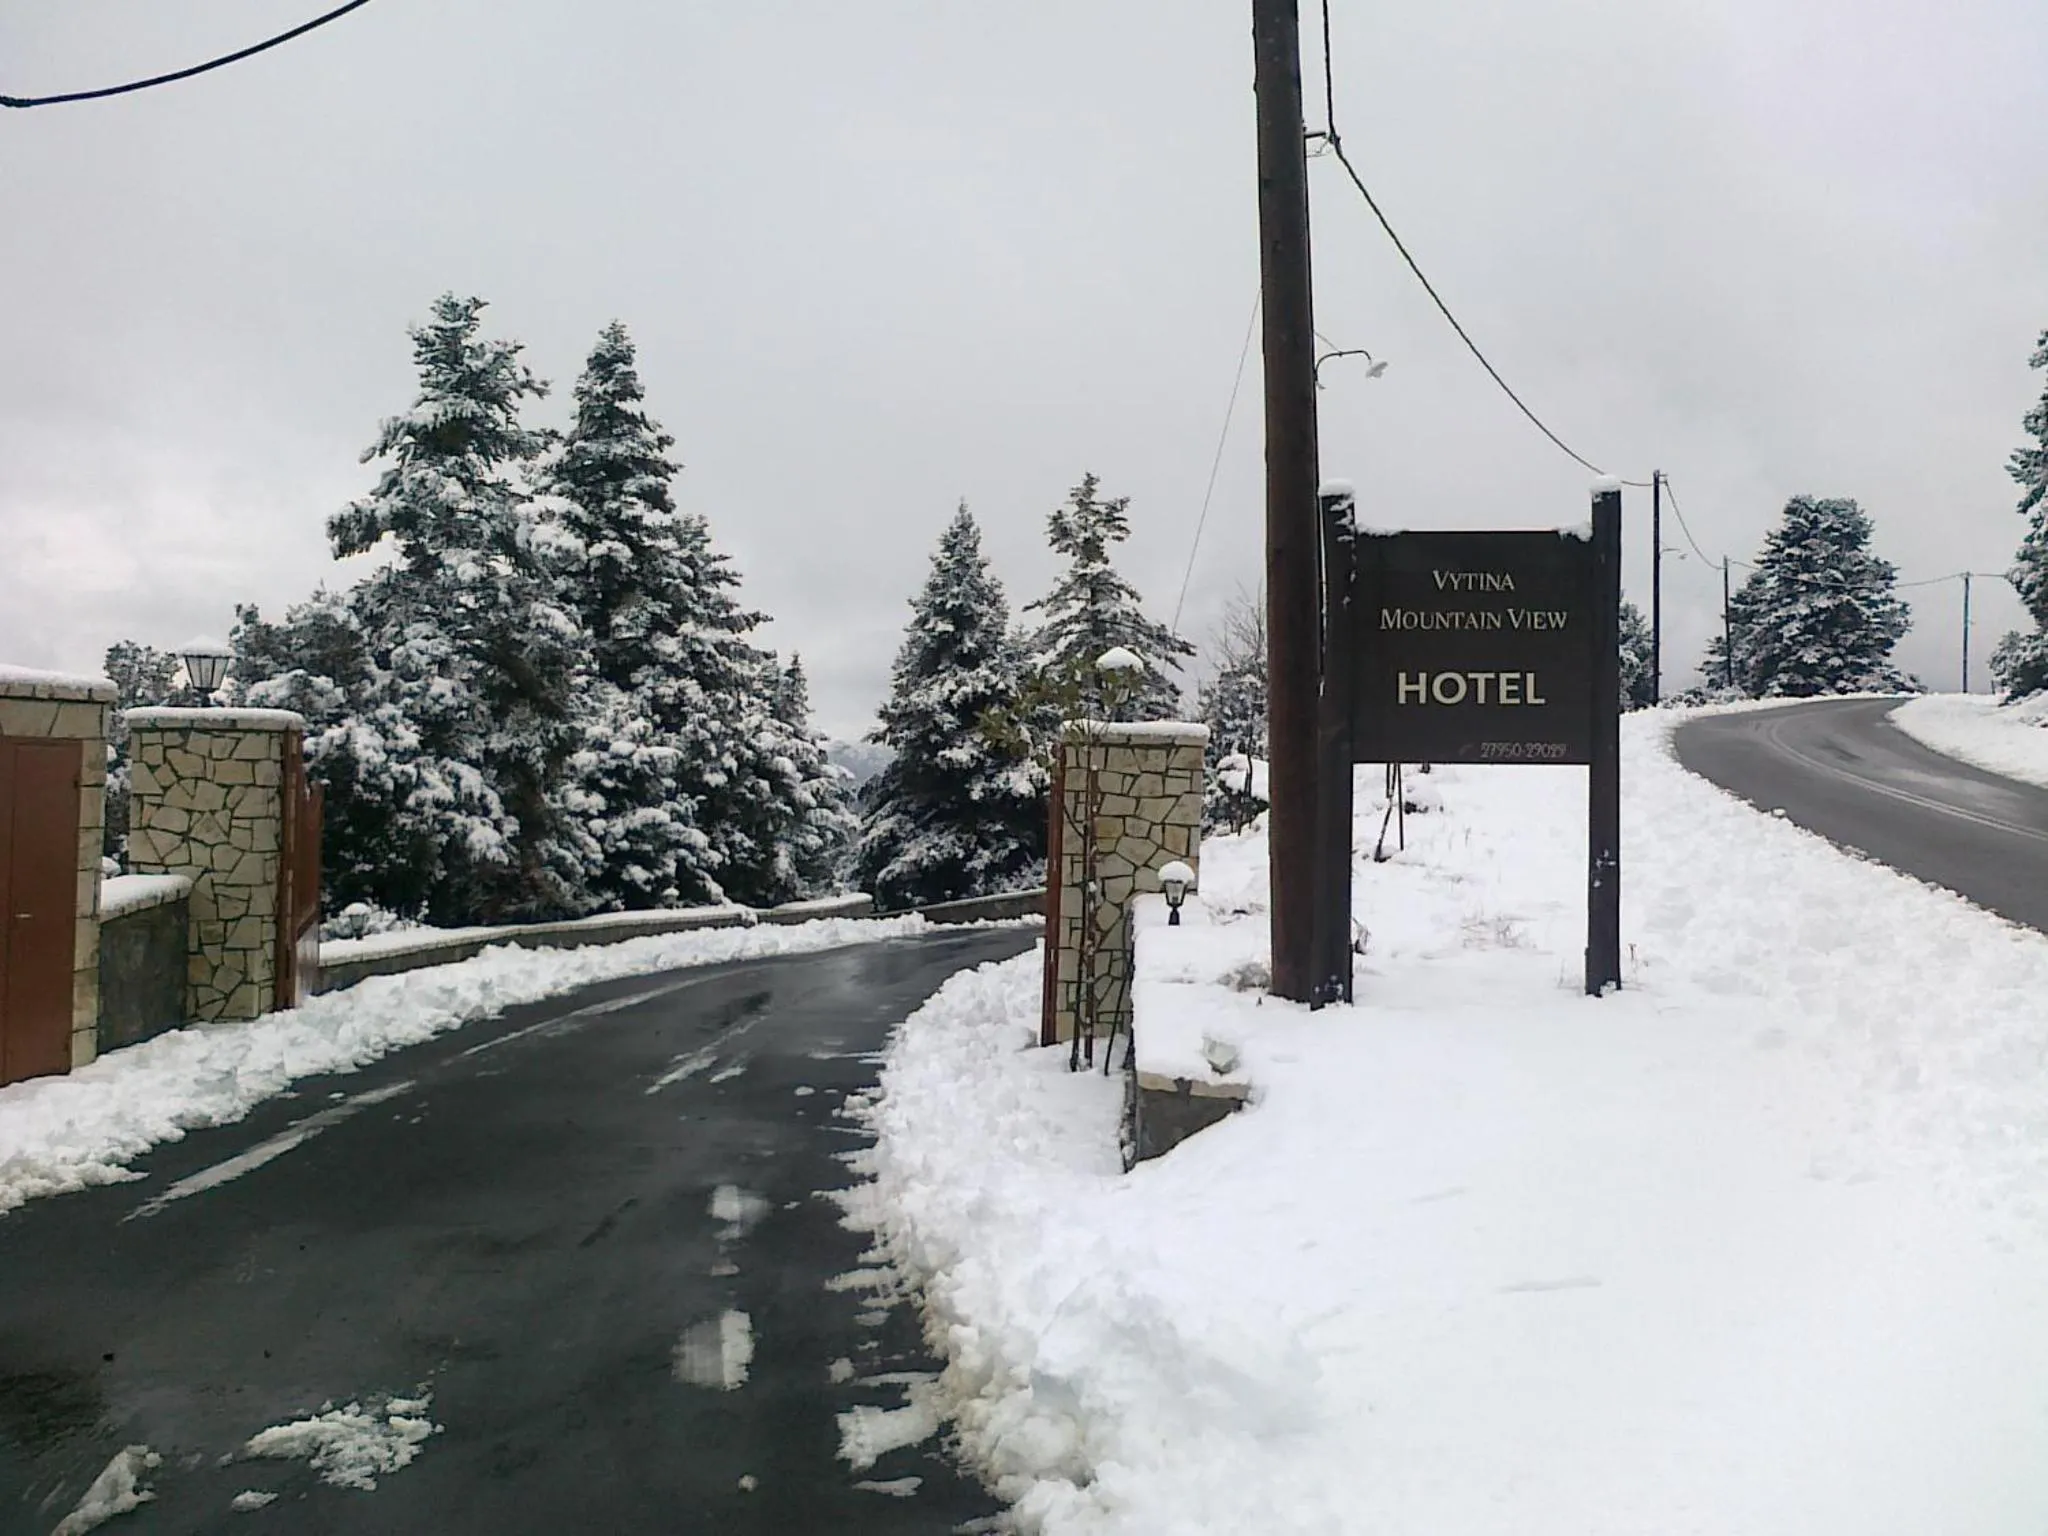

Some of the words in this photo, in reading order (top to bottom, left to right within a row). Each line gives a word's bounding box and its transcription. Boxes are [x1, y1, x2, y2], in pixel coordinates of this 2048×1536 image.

[1432, 569, 1515, 591] VYTINA
[1380, 608, 1501, 630] MOUNTAIN
[1507, 608, 1568, 630] VIEW
[1397, 671, 1546, 705] HOTEL
